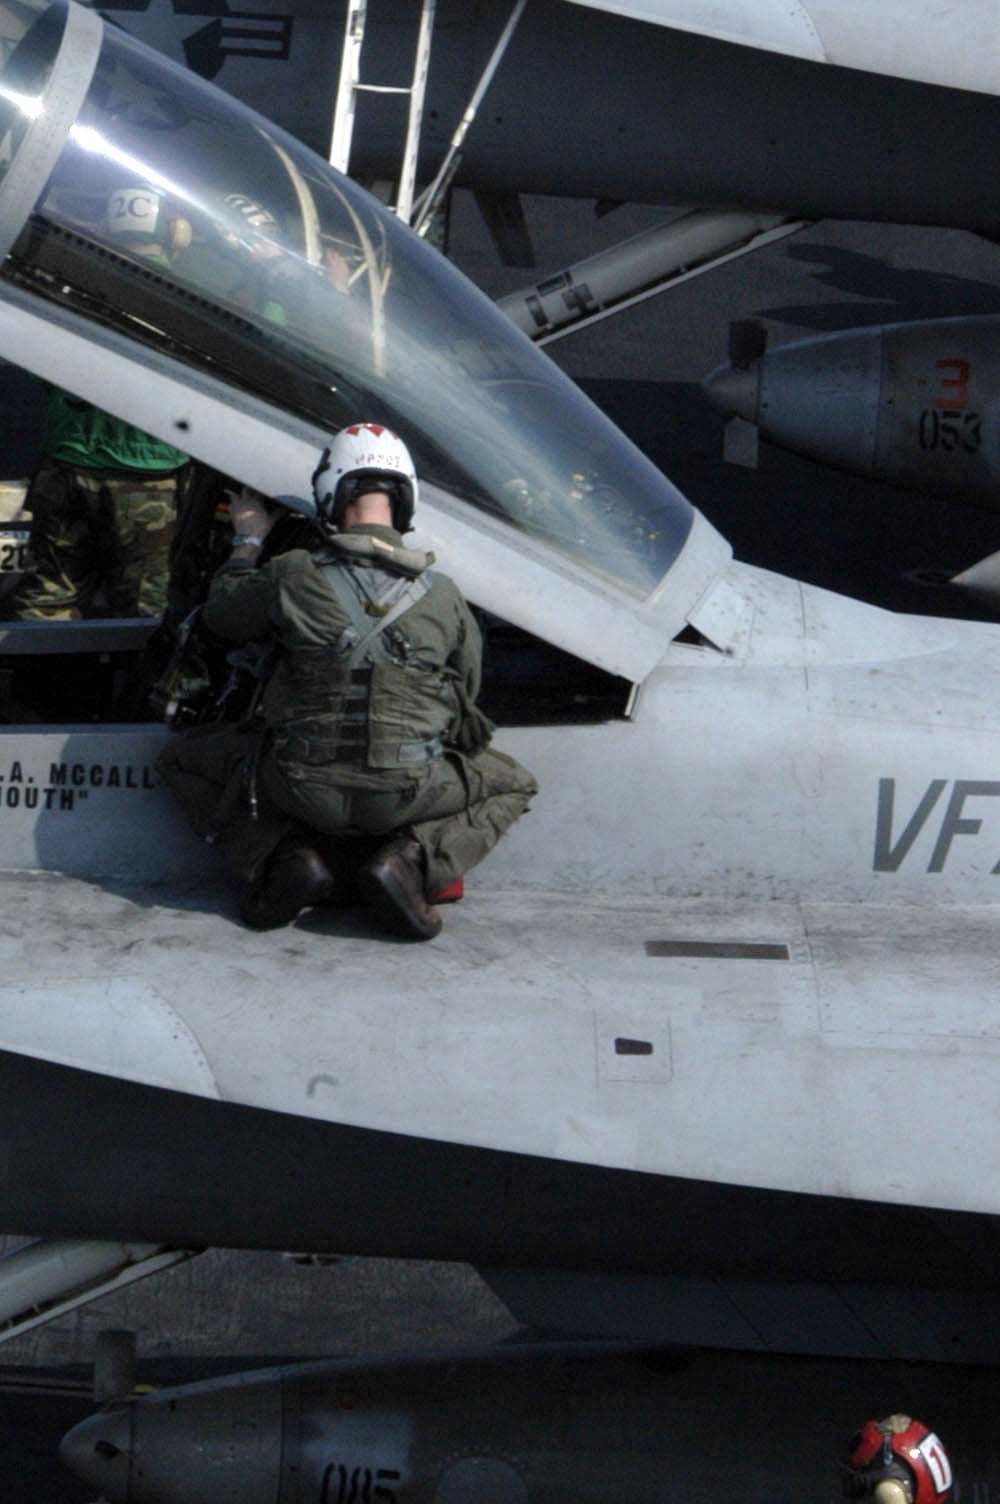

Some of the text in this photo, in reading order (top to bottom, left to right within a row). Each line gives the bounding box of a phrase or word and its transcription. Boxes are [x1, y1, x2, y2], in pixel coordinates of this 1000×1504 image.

[111, 196, 151, 218] 2C
[933, 359, 969, 409] 3
[918, 409, 982, 453] 053
[872, 777, 1000, 874] VF
